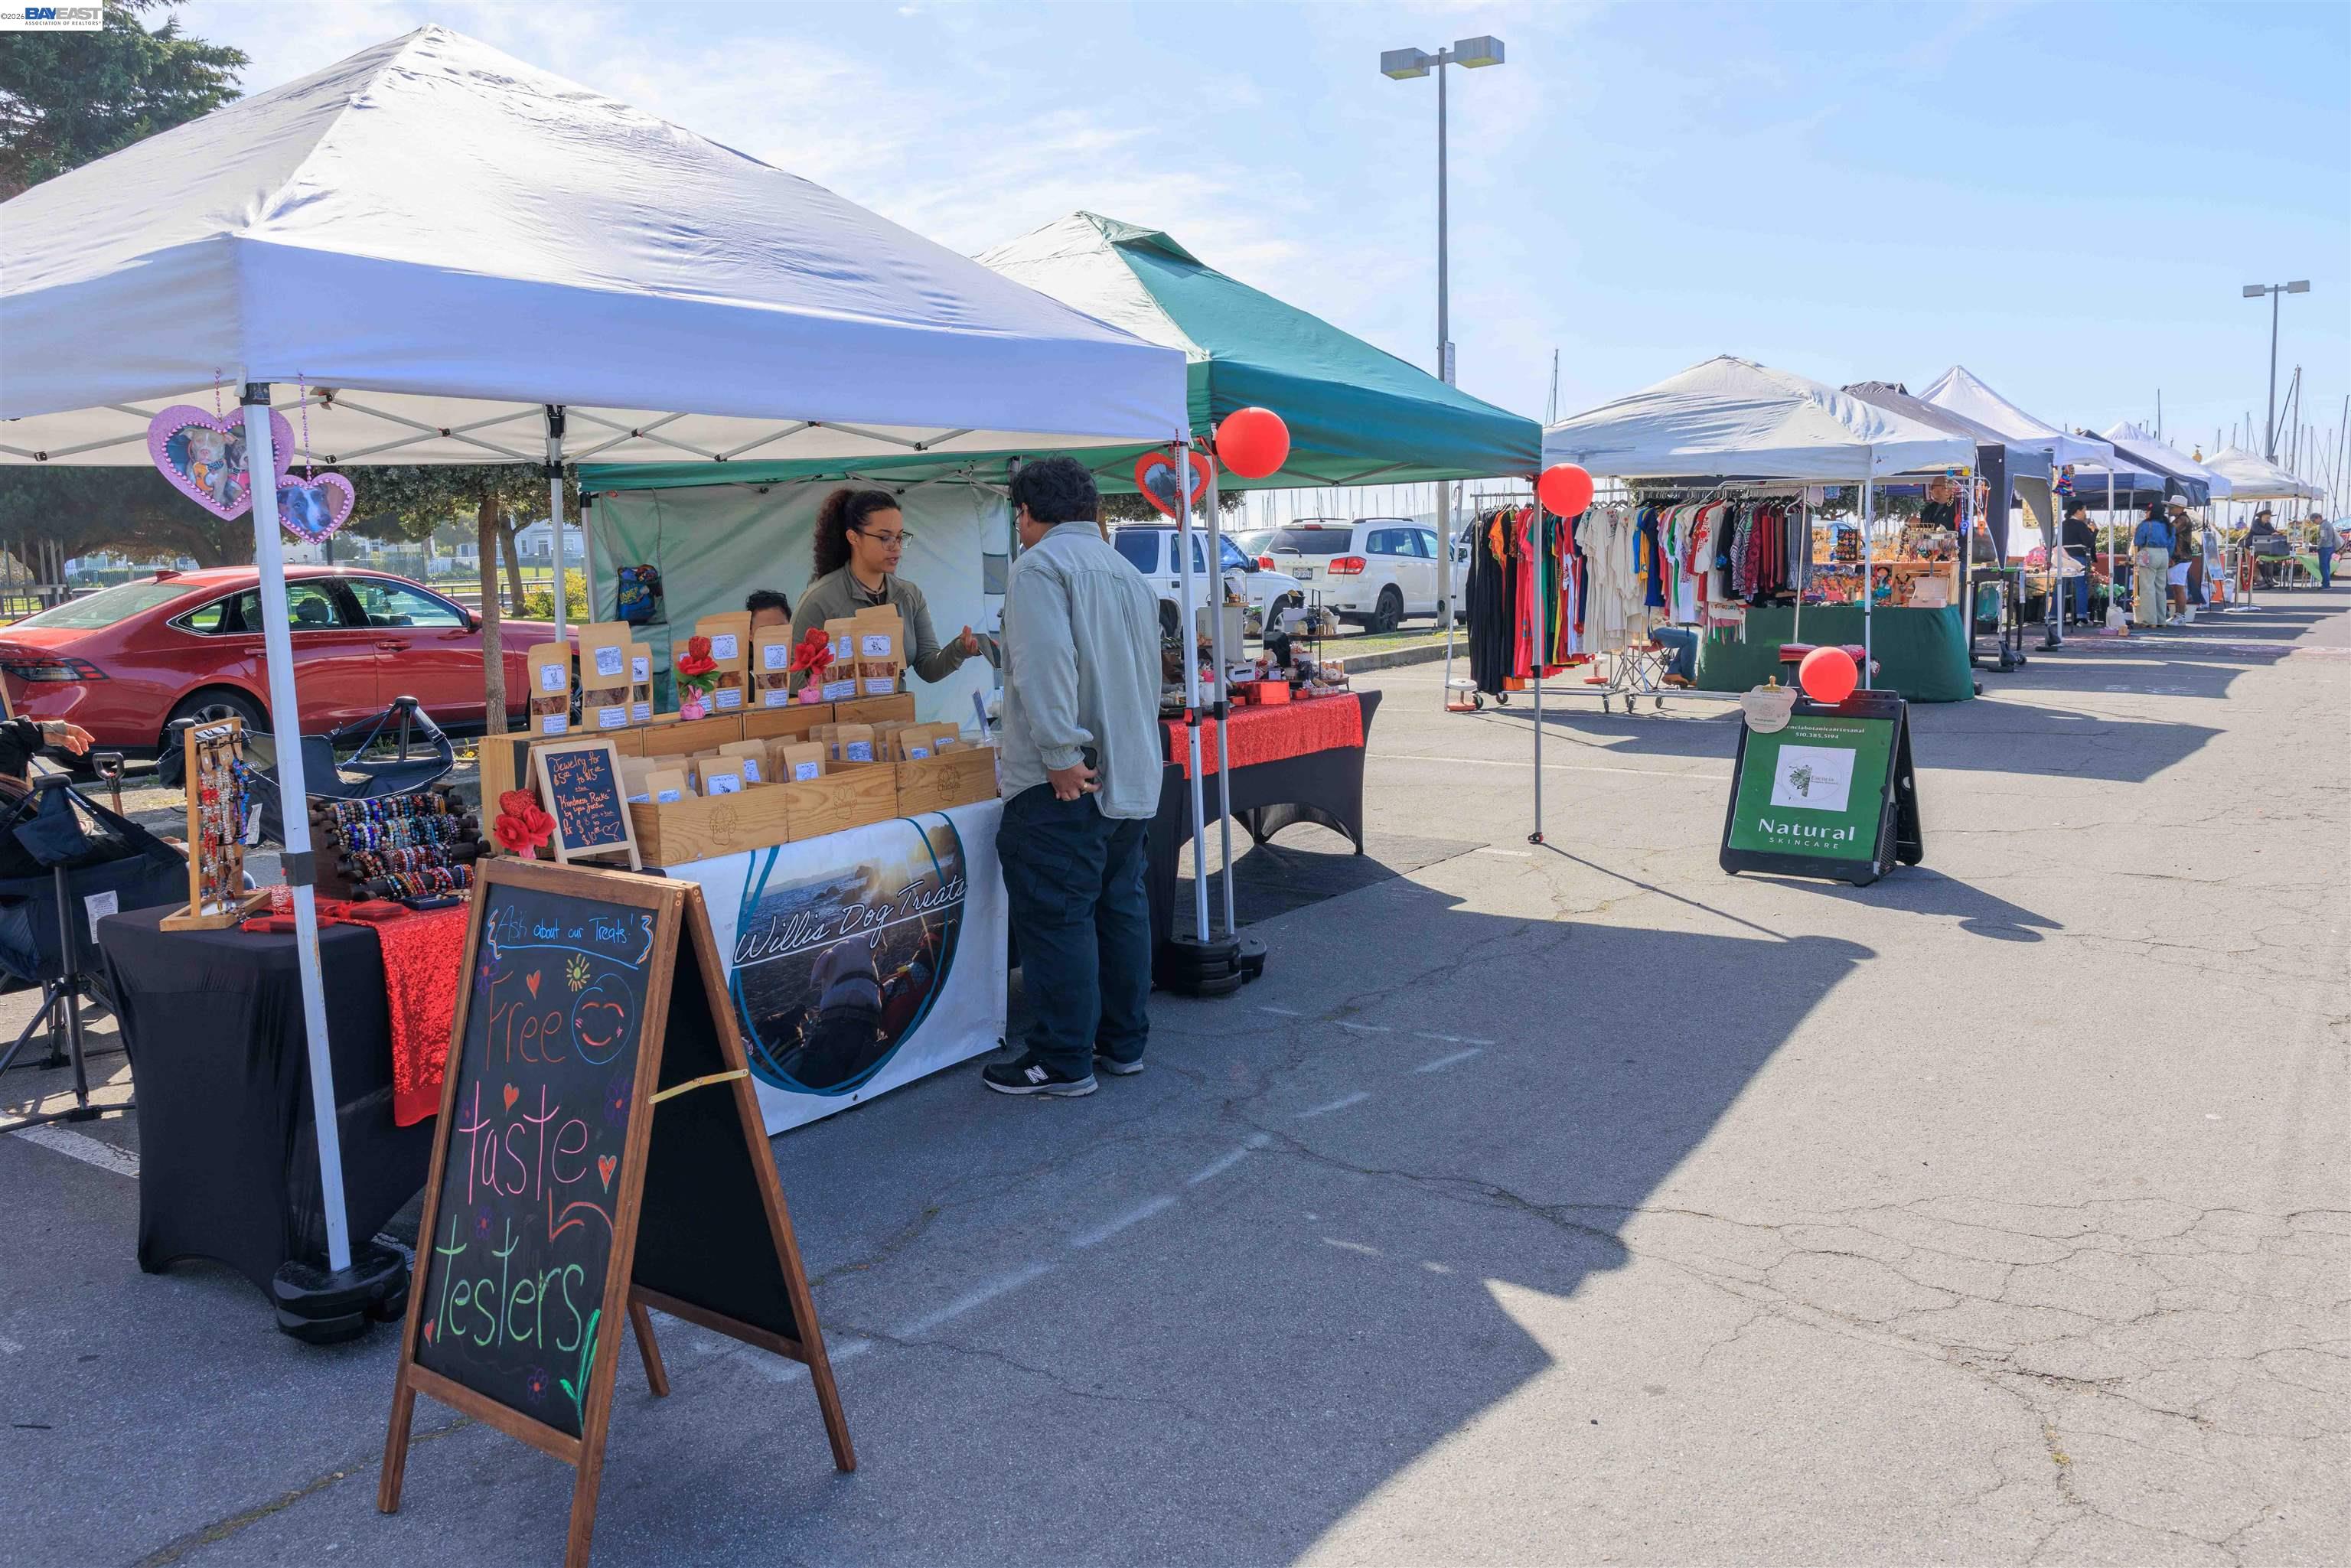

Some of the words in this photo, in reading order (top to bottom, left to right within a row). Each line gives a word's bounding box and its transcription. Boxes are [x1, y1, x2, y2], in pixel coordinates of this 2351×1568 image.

[548, 755, 587, 774] Jewelry
[589, 751, 601, 765] for
[576, 773, 585, 785] to
[1759, 818, 1855, 841] Natural
[1769, 837, 1838, 849] SKINCARE
[495, 905, 527, 941] Ask
[533, 918, 560, 940] about
[568, 927, 585, 938] our
[733, 913, 832, 963] Willis
[839, 902, 894, 949] Dog
[897, 875, 969, 916] Treats
[486, 970, 566, 1071] Free
[1024, 1064, 1049, 1084] N
[459, 1081, 589, 1205] taste
[436, 1214, 584, 1353] testers
